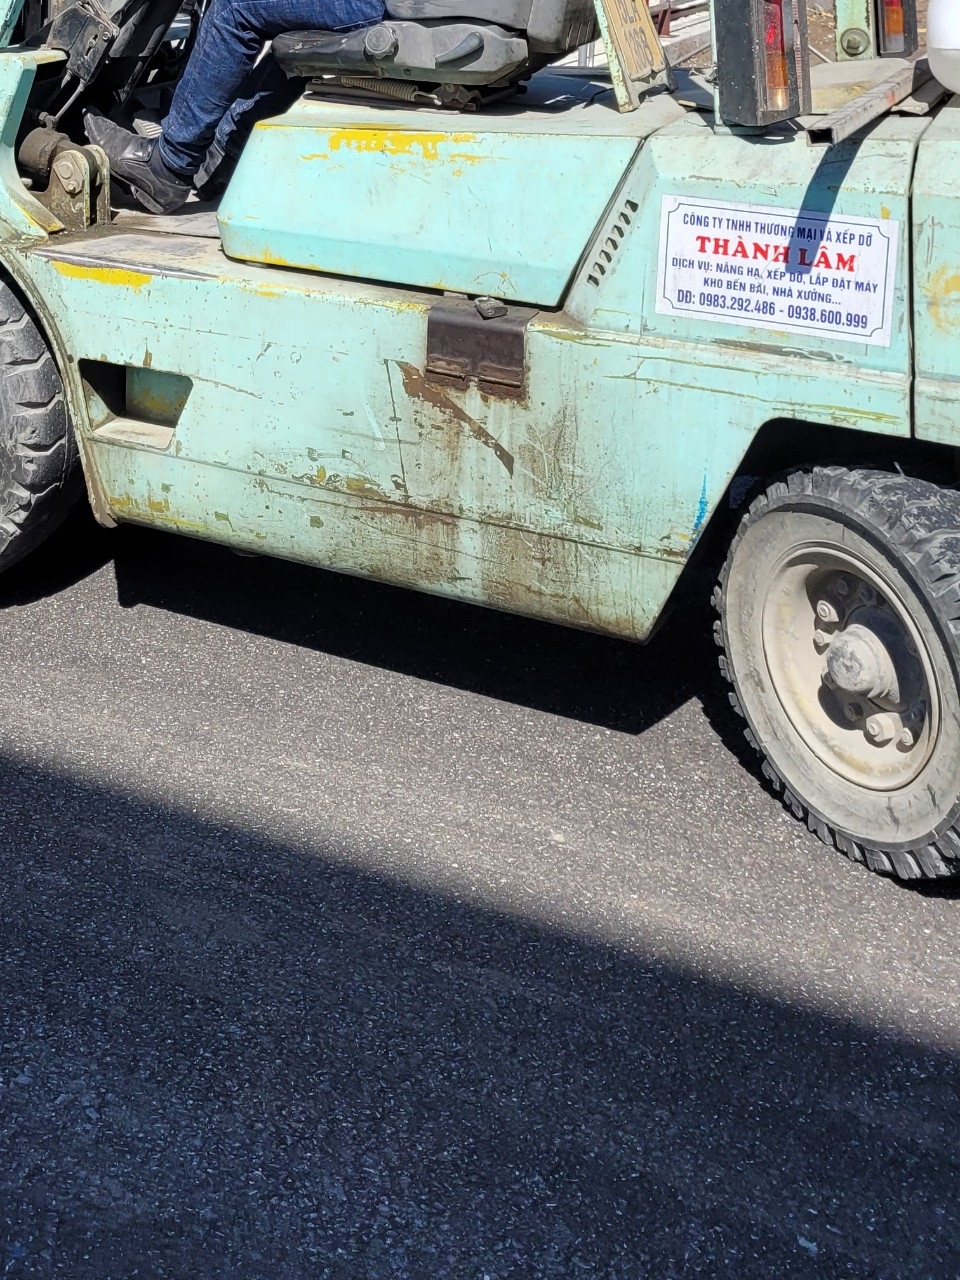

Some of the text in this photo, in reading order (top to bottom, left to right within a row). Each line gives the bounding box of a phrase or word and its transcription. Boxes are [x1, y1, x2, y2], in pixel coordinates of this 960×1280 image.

[683, 212, 710, 227] CÔNG
[712, 217, 723, 229] TY
[726, 219, 751, 232] TNHH
[754, 221, 794, 238] THƯƠNG
[797, 226, 817, 242] MẠI
[820, 228, 832, 242] VÀ
[835, 228, 855, 243] XẾP
[696, 235, 857, 272] THÀNH LÂM
[672, 257, 694, 269] DỊCH
[698, 261, 713, 273] VỤ:
[716, 262, 743, 276] NÂNG
[767, 267, 786, 281] XẾP
[855, 280, 878, 293] MÁY
[703, 277, 723, 288] KHO
[726, 278, 745, 292] BẾN
[772, 285, 793, 298] NHÀ
[699, 292, 775, 316] 0983.292.486
[787, 304, 868, 329] 0938.600.999
